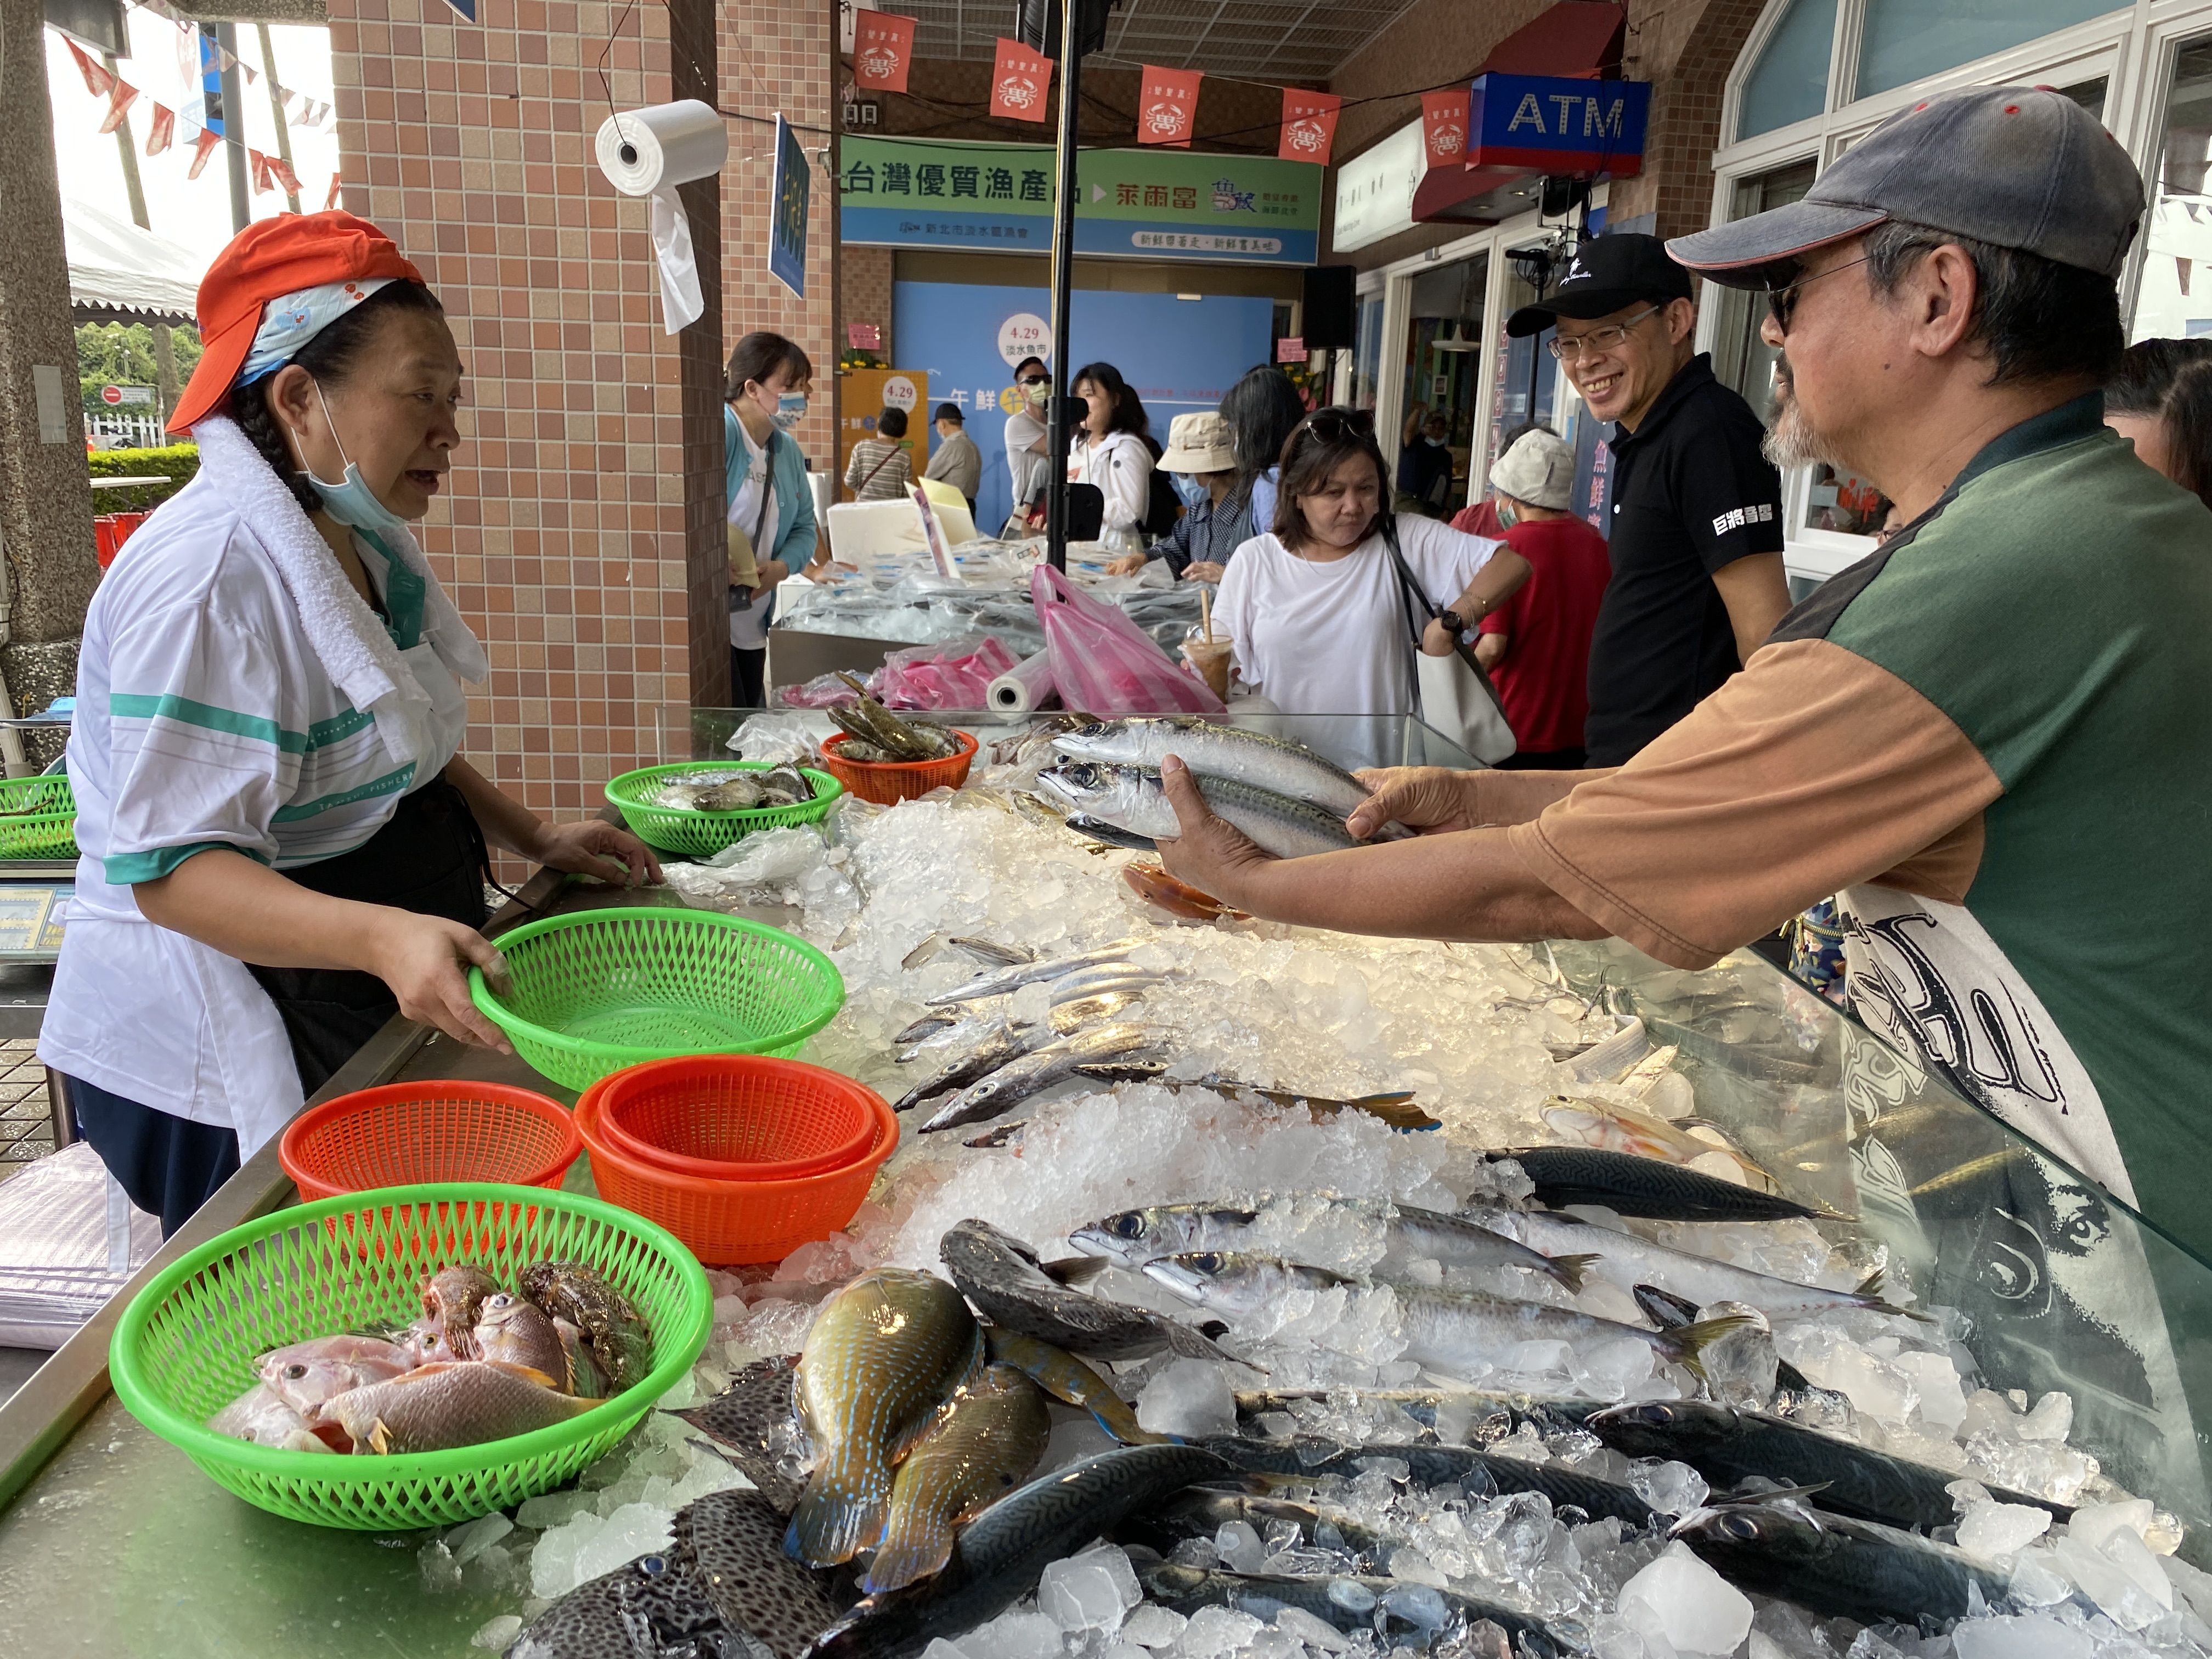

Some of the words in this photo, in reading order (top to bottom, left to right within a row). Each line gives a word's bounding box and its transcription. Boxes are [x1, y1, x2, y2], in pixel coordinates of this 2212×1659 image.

[1507, 93, 1624, 139] ATM
[1116, 183, 1197, 209] 萊爾富
[1011, 327, 1039, 340] 4.29
[1005, 344, 1047, 357] 淡水魚市
[887, 386, 913, 398] 4.29
